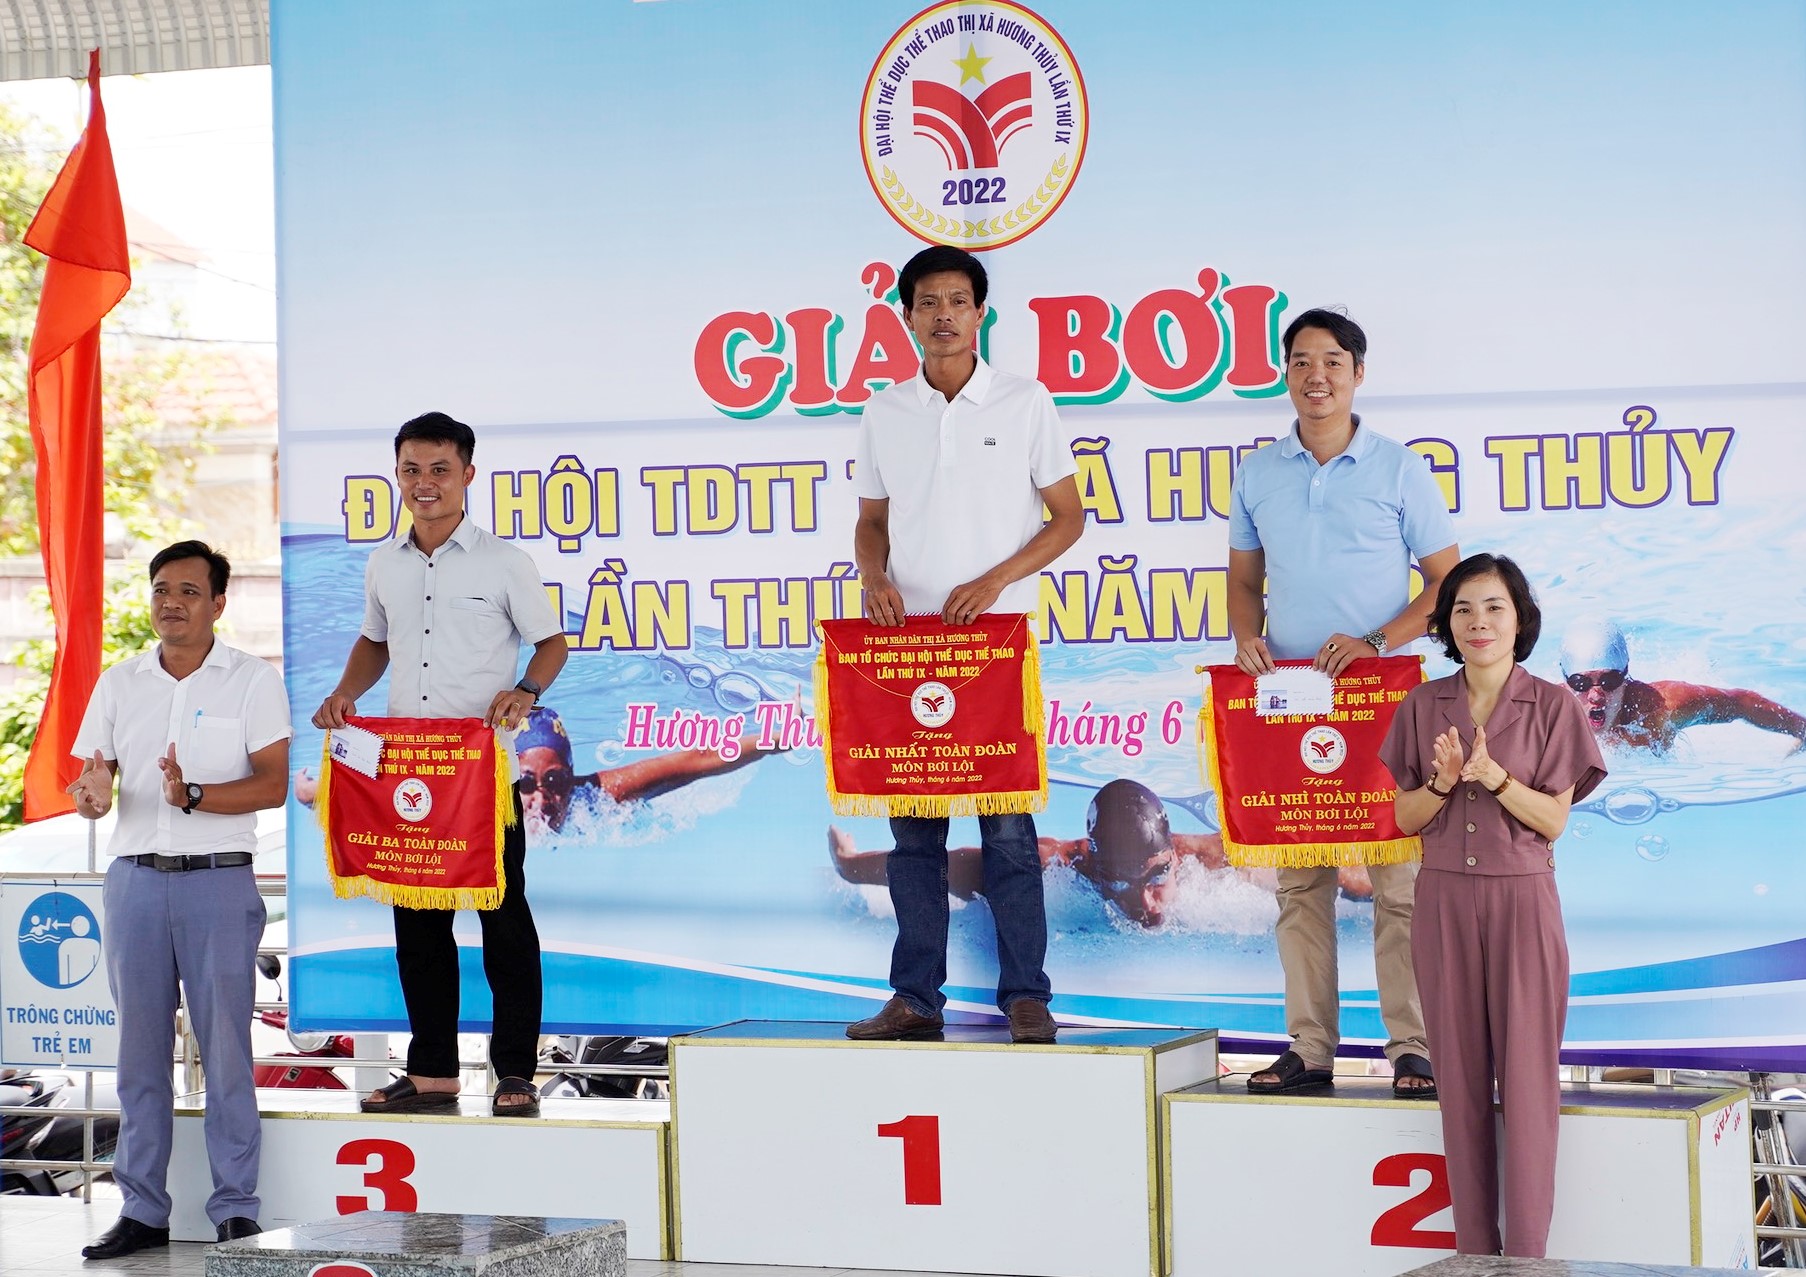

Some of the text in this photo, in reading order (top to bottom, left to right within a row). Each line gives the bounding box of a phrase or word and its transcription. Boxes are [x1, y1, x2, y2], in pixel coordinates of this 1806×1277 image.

[924, 18, 955, 43] THAO
[957, 14, 975, 34] THỊ
[978, 12, 994, 32] XÃ
[904, 28, 928, 59] THỂ
[996, 18, 1036, 50] HƯƠNG
[888, 54, 910, 83] DỤC
[1031, 41, 1058, 74] THỦY
[1048, 72, 1071, 100] LẦN
[873, 109, 893, 131] HỘI
[1056, 101, 1075, 128] THỨ
[876, 134, 894, 157] ĐẠI
[1055, 131, 1071, 144] IX
[942, 177, 1006, 205] 2022
[694, 262, 1284, 410] GIẢ BƠI
[491, 455, 620, 553] HỘI
[640, 461, 827, 535] TDTT
[1484, 405, 1735, 511] THỦY
[1040, 554, 1232, 643] NĂM
[874, 636, 888, 645] BAN
[889, 634, 907, 644] NHÂN
[908, 634, 922, 644] DÂN
[838, 652, 858, 664] BAN
[874, 649, 899, 663] CHỨC
[901, 650, 916, 664] ĐẠI
[918, 648, 932, 664] HỘI
[954, 649, 972, 663] DỤC
[991, 647, 1015, 660] THAO
[917, 668, 926, 678] IX
[936, 665, 958, 678] NĂM
[960, 666, 980, 678] 2022
[1228, 698, 1246, 710] BAN
[1347, 692, 1366, 706] DỤC
[1352, 710, 1375, 721] 2022
[624, 705, 744, 759] Hương
[1047, 700, 1148, 757] háng
[1162, 700, 1184, 744] 6
[387, 748, 399, 761] ĐẠI
[401, 748, 414, 762] HỘI
[432, 750, 448, 762] DỤC
[466, 749, 482, 760] THAO
[849, 740, 1017, 759] GIẢI NHẤT TOÀN ĐOÀN
[400, 764, 408, 774] IX
[416, 764, 434, 775] NĂM
[436, 765, 456, 776] 2022
[892, 760, 975, 774] MÔN BƠI LỘI
[886, 776, 907, 784] Hương
[928, 776, 944, 784] tháng
[1242, 790, 1396, 807] GIẢI NHÌ TOÀN ĐOÀN
[1280, 806, 1368, 821] MÔN BƠI LỘI
[1275, 824, 1297, 833] Hương
[1316, 823, 1334, 832] tháng
[348, 831, 467, 851] GIẢI BA TOÀN ĐOÀN
[374, 850, 442, 866] MÔN BƠI LỘI
[6, 1004, 116, 1026] TRÔNG CHỪNG
[32, 1030, 91, 1054] TRẺ EM
[878, 1115, 941, 1205] 1
[336, 1139, 417, 1215] 3
[1371, 1153, 1458, 1249] 2
